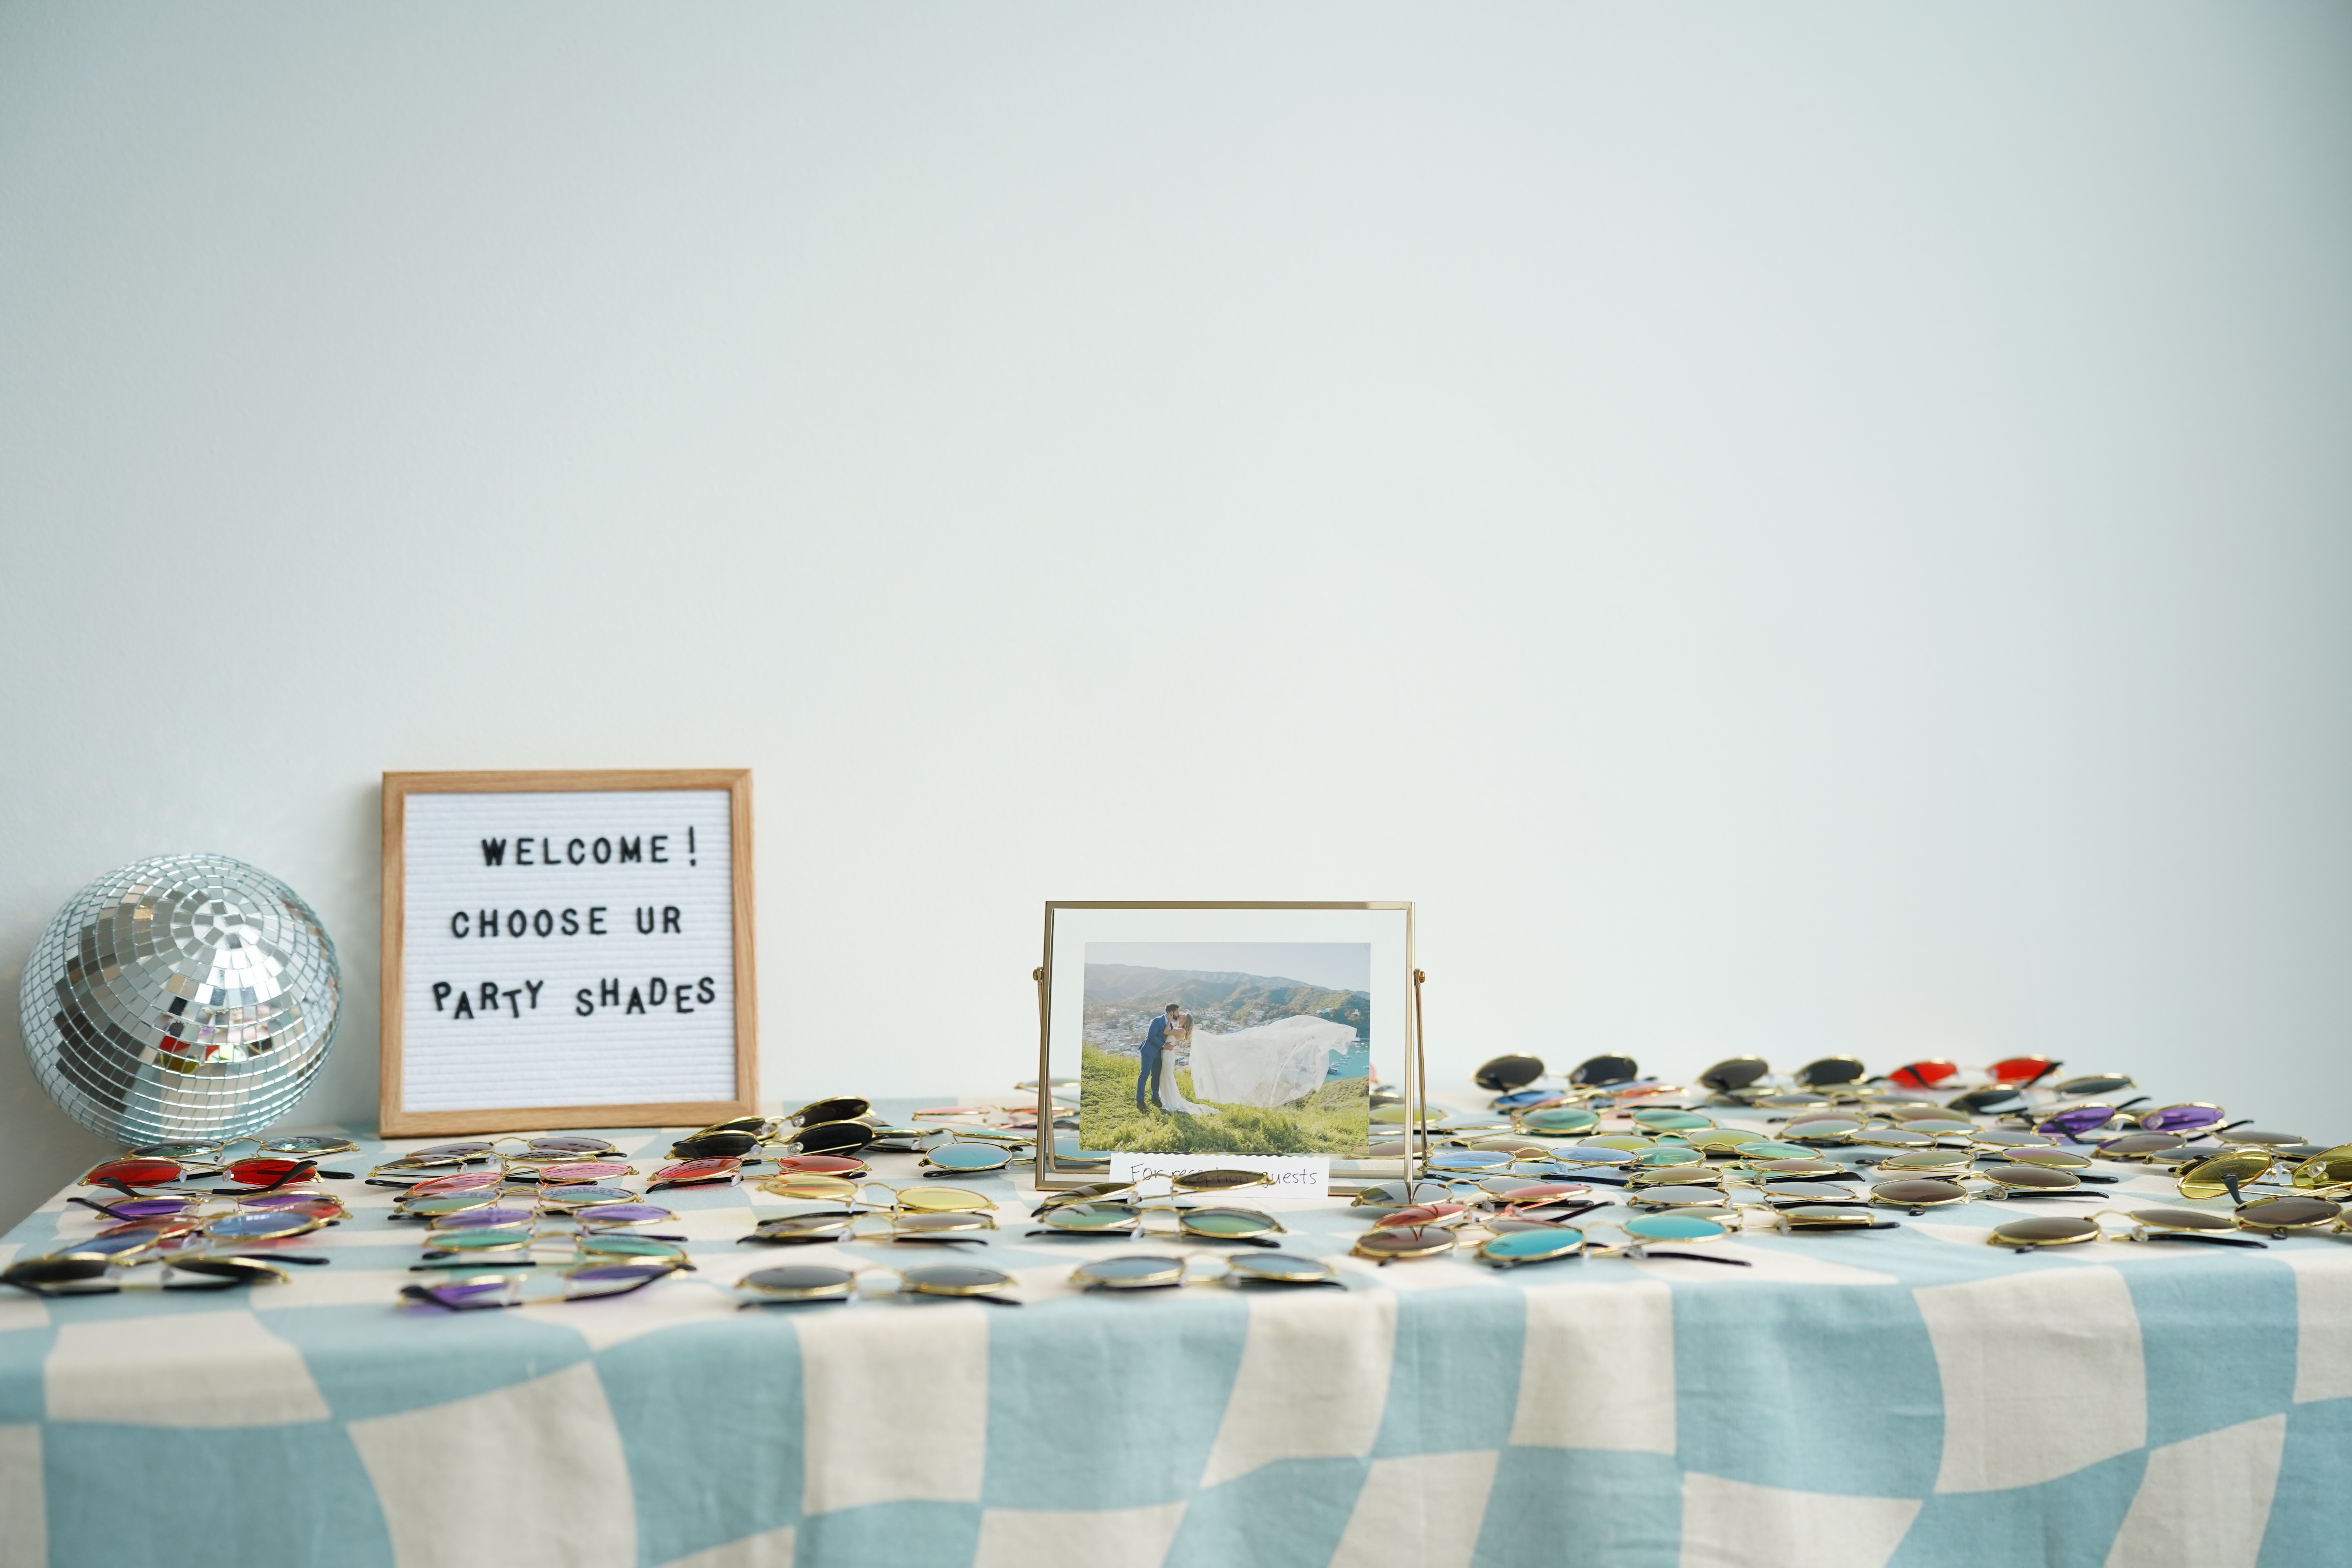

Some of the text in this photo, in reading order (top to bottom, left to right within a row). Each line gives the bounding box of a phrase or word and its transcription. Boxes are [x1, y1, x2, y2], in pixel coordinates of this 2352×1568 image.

[451, 906, 681, 939] CHOOSE UR
[432, 976, 715, 1020] PARTY SHADES
[1131, 1163, 1164, 1181] For
